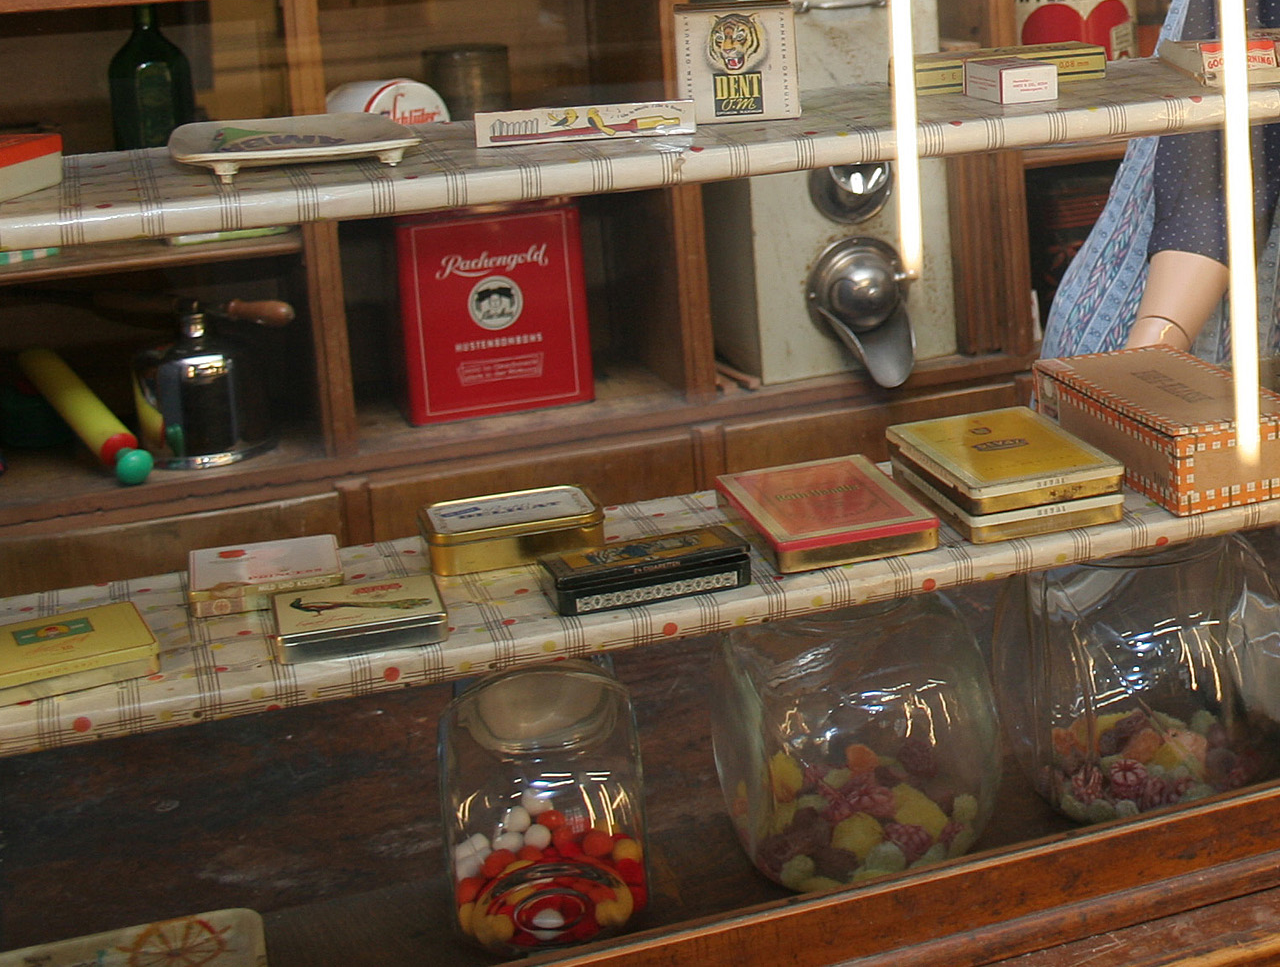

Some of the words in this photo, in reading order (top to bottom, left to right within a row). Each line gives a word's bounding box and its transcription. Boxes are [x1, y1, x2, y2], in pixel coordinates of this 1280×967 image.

[714, 74, 762, 101] DENT
[435, 242, 549, 281] Rachengold
[454, 331, 543, 353] HUSTENBONBONS
